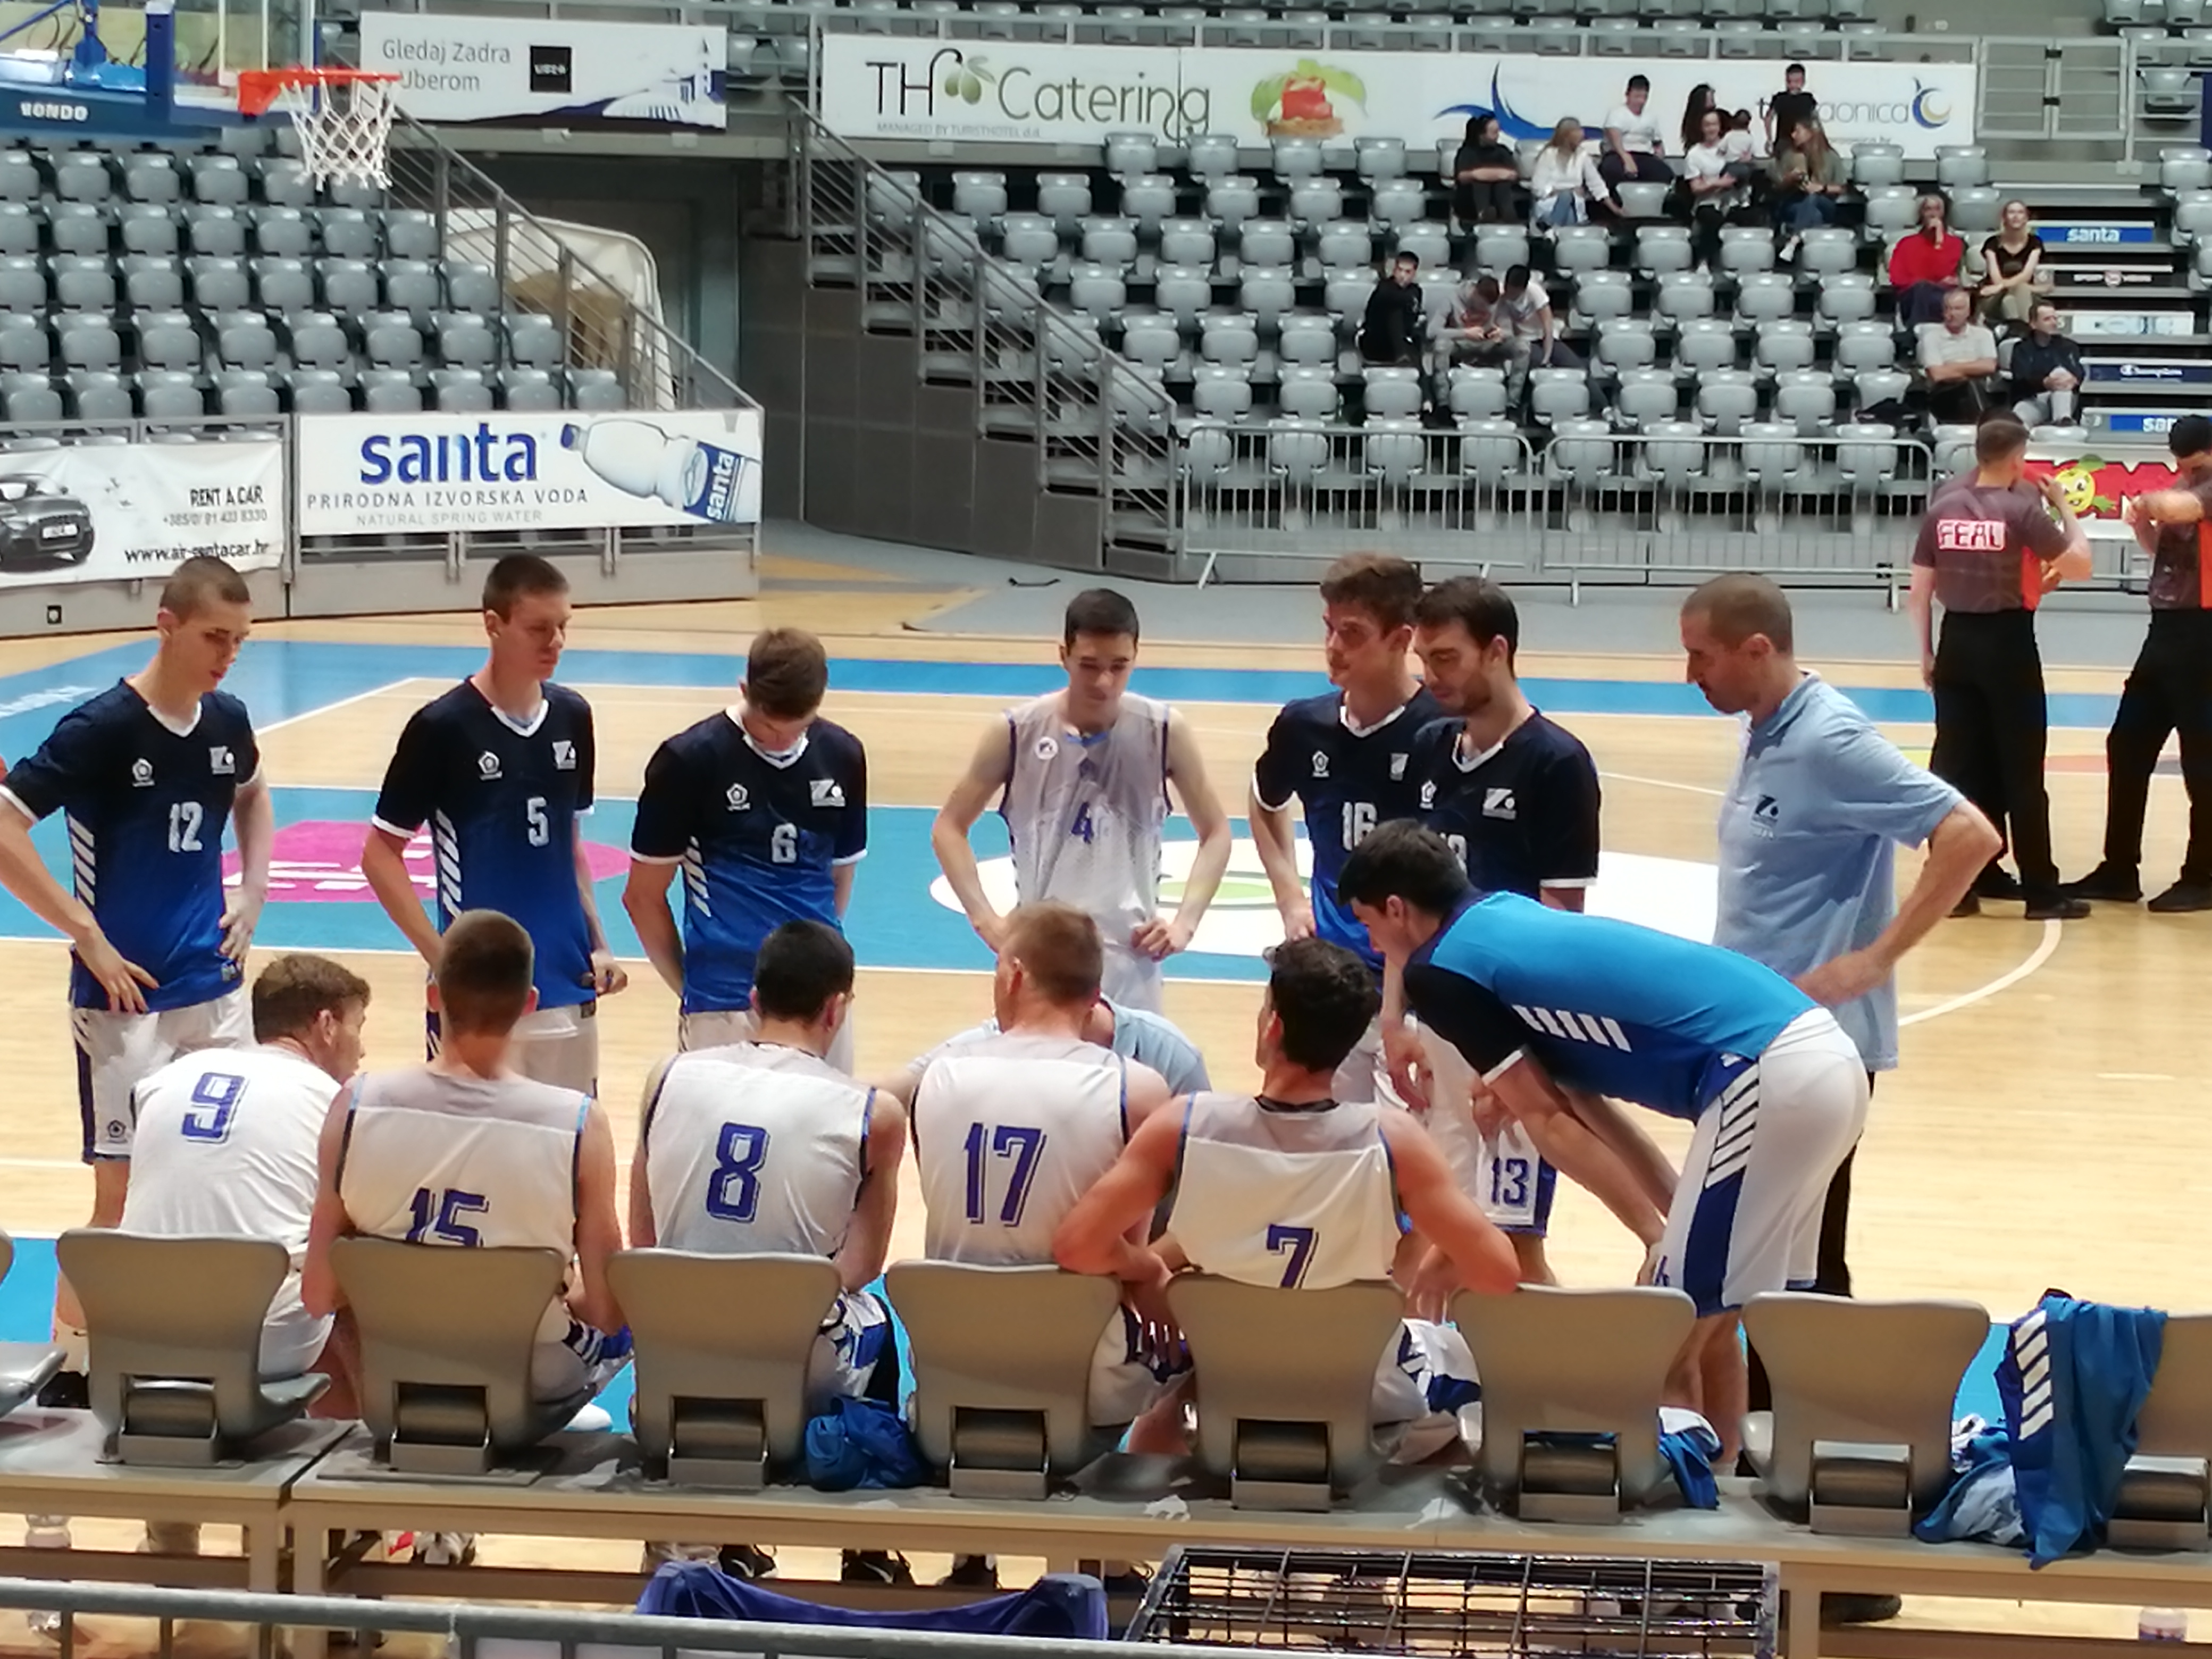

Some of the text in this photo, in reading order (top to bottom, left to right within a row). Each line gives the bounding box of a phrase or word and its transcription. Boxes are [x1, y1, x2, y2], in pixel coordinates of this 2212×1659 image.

[382, 38, 511, 65] Gledaj Zadra
[877, 122, 932, 133] MANAGED
[935, 124, 948, 135] BY
[998, 66, 1210, 142] Catering
[2066, 227, 2121, 242] santa
[361, 422, 538, 485] santa
[190, 484, 263, 507] RENT A CAR
[307, 489, 589, 509] PRIRODNA IZVORSKA VODA
[706, 451, 735, 520] santa
[356, 510, 542, 526] NATURAL SPRING WATER
[168, 801, 204, 853] 12
[526, 795, 550, 847] 5
[771, 822, 798, 863] 6
[1070, 800, 1094, 845] 4
[1342, 801, 1377, 851] 16
[180, 1071, 249, 1145] 9
[706, 1121, 771, 1225] 8
[963, 1121, 1048, 1227] 17
[1491, 1157, 1530, 1209] 13
[405, 1187, 490, 1247] 15
[1266, 1223, 1320, 1289] 7
